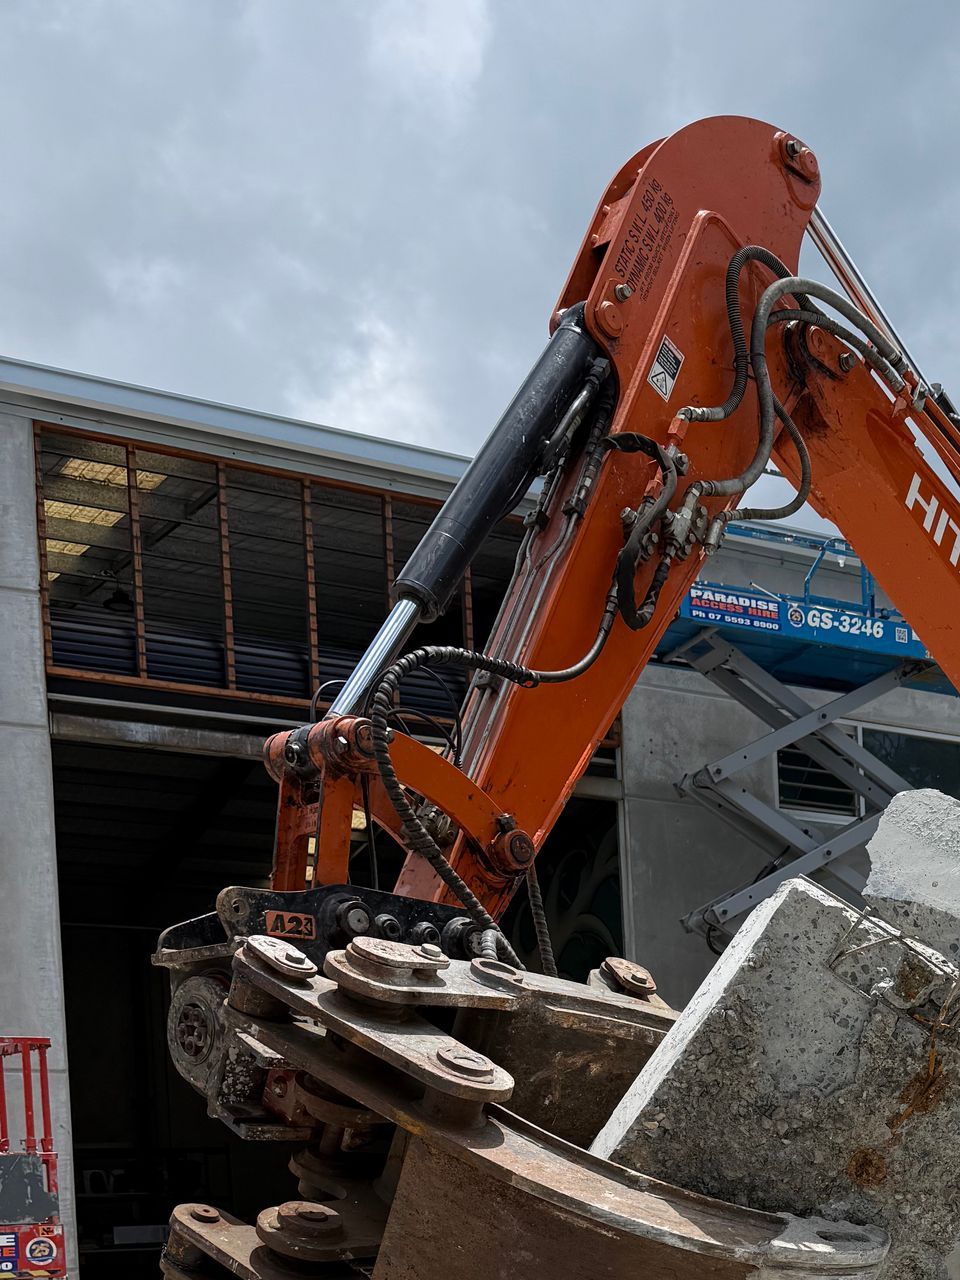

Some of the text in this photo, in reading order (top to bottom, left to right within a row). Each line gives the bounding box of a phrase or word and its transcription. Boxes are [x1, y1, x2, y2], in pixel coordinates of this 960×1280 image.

[615, 239, 635, 278] STATIC
[641, 189, 655, 212] 450
[626, 247, 649, 292] DYNAMIC
[653, 202, 667, 223] 400
[690, 588, 779, 612] PARADISE
[691, 598, 779, 619] ACCESS HIRE
[692, 610, 706, 618] Ph
[708, 613, 721, 621] 07
[724, 616, 751, 626] 5593
[807, 610, 884, 639] GS-3246
[31, 1243, 50, 1258] 25
